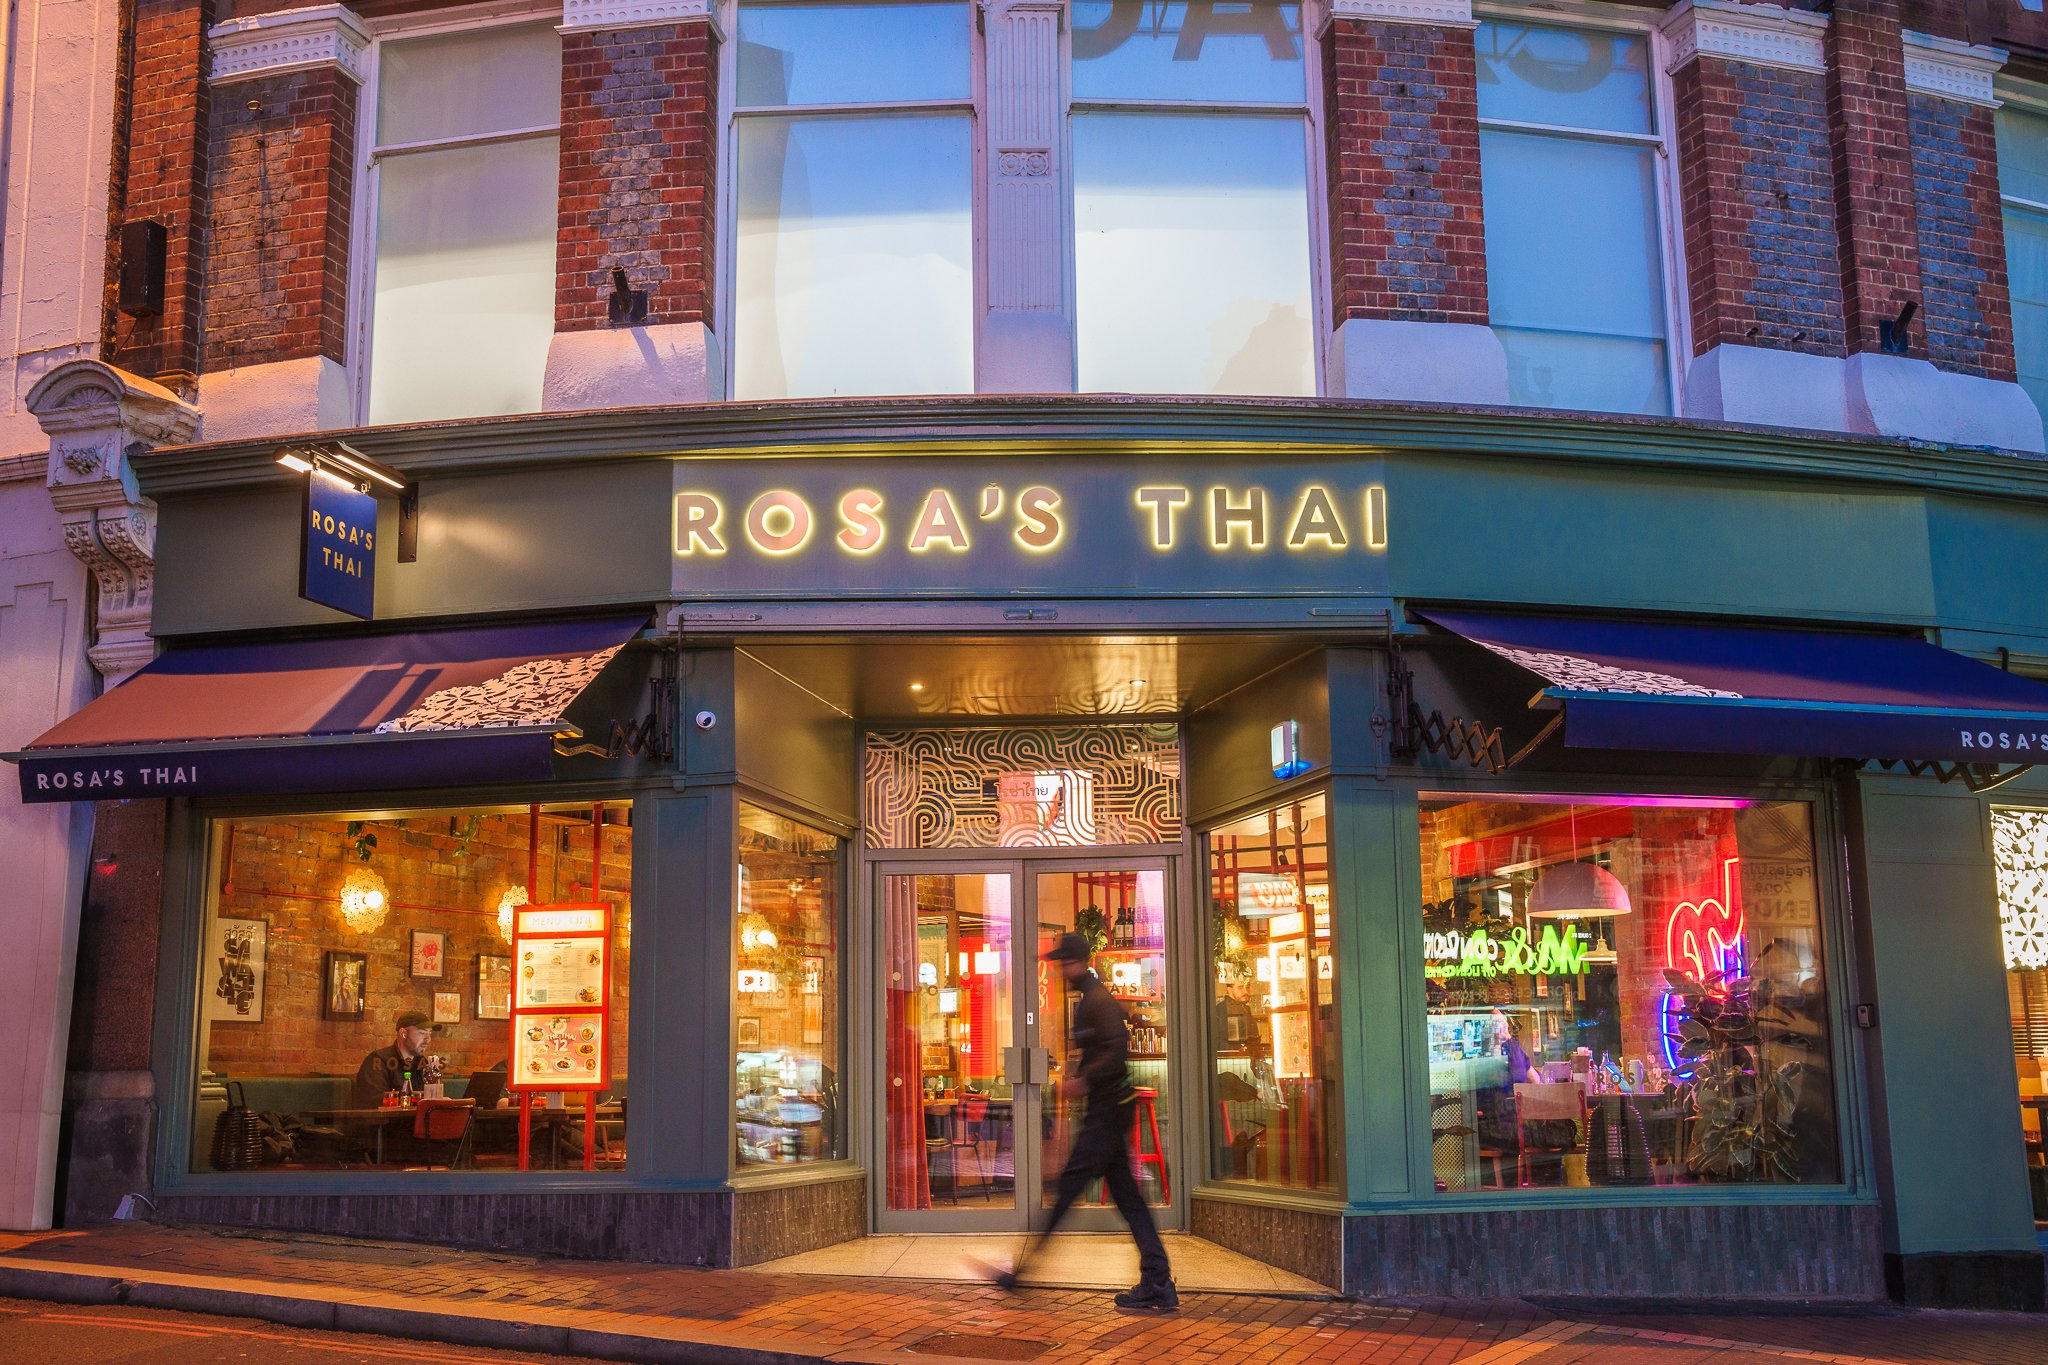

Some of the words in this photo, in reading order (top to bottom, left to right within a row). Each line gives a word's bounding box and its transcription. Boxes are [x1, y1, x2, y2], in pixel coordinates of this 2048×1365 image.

[311, 509, 374, 551] ROSA'S
[675, 486, 1061, 552] ROSA'S
[1139, 487, 1386, 546] THAI
[322, 547, 362, 578] THAI
[1961, 730, 2048, 751] ROSA'S
[36, 769, 124, 790] ROSA'S
[139, 766, 197, 785] THAI
[553, 1039, 568, 1052] 12
